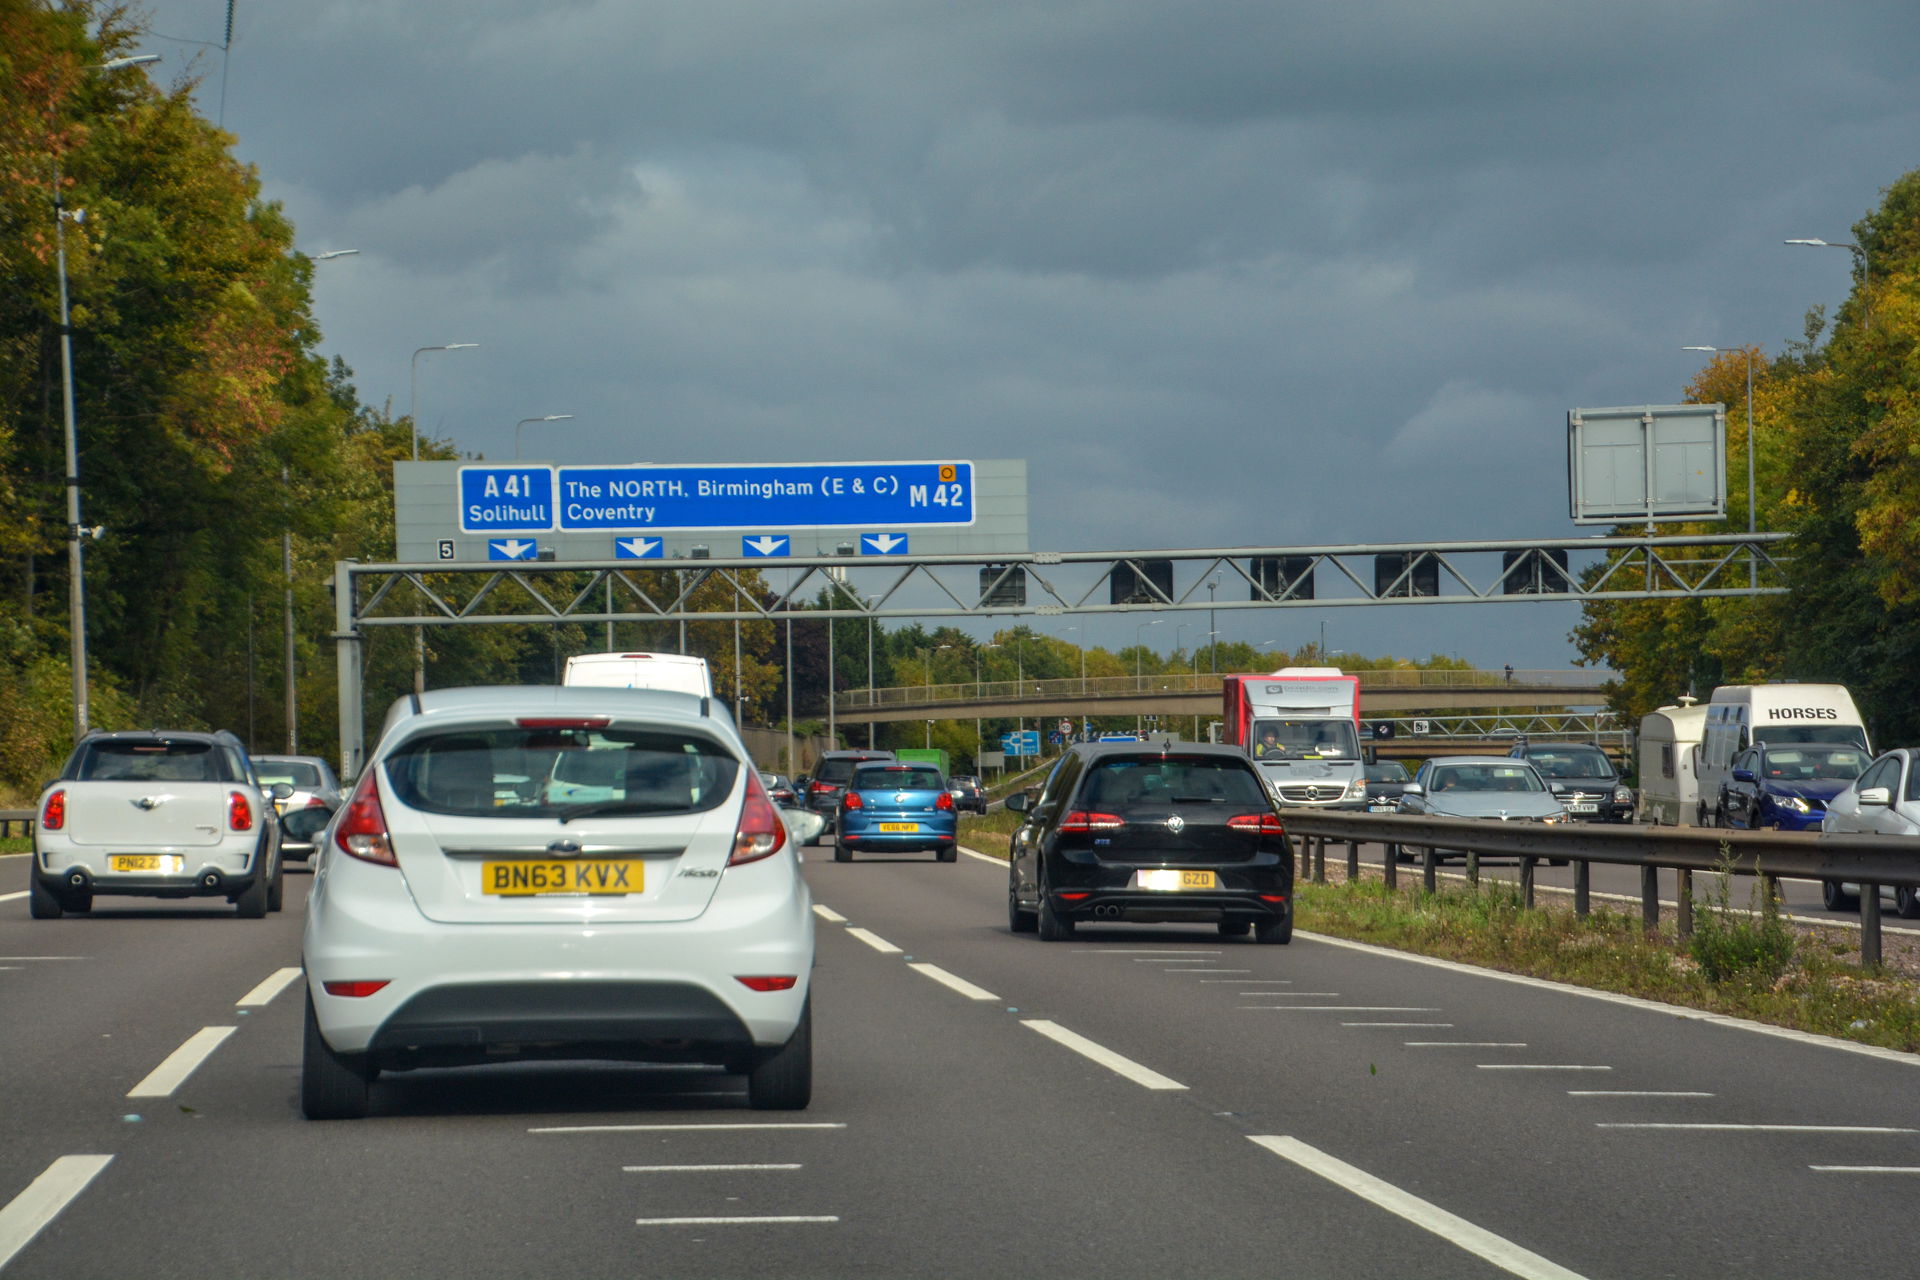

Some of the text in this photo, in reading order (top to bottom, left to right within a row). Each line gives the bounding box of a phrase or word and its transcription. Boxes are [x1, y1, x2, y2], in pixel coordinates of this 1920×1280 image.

[566, 481, 601, 498] The
[698, 479, 812, 499] Birmingham
[852, 478, 865, 494] &
[469, 504, 546, 522] Solihull
[567, 503, 655, 523] Coventry
[441, 543, 452, 557] 5
[1768, 707, 1837, 719] HORSES
[118, 857, 144, 869] PN12
[493, 864, 629, 888] BN63 KVX
[1183, 872, 1209, 885] GZD
